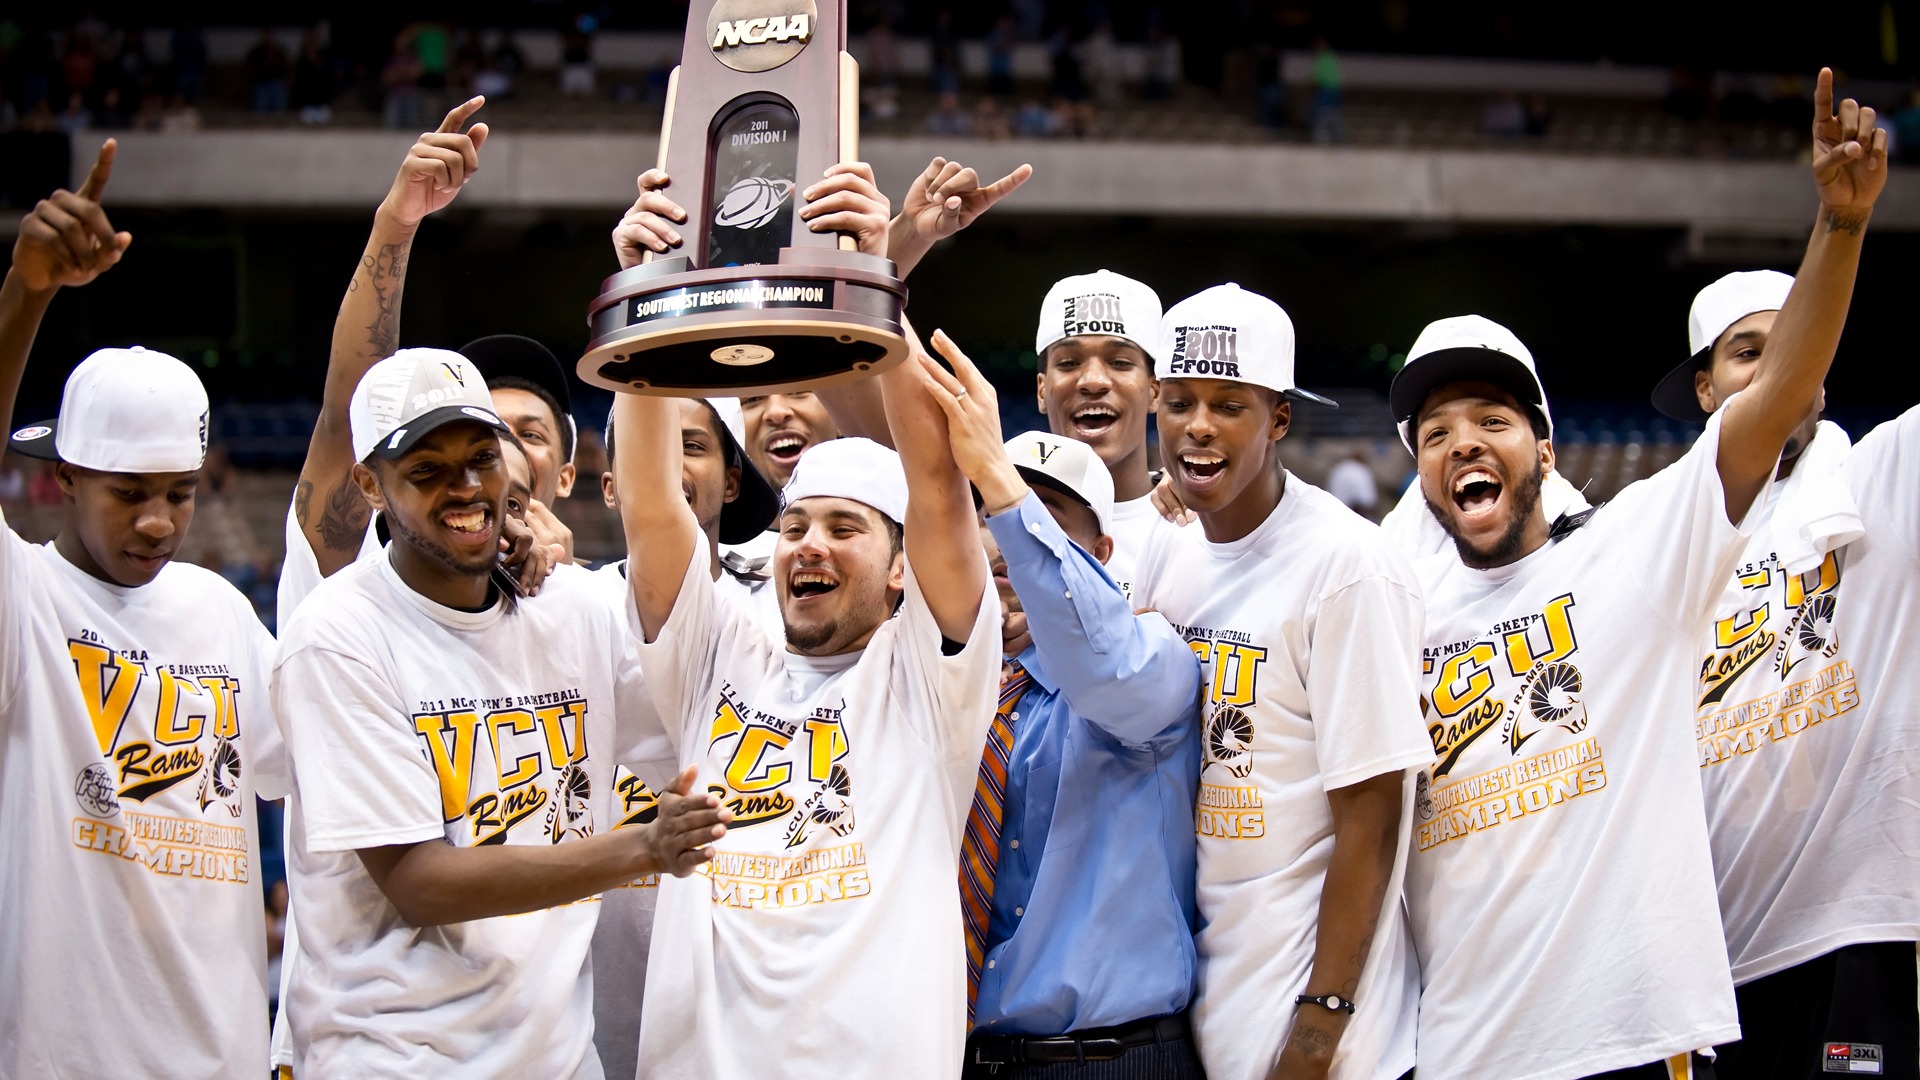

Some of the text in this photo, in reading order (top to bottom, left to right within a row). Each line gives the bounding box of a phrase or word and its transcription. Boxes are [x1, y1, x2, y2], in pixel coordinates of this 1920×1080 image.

[712, 14, 811, 51] NCAA
[731, 130, 787, 147] DIVISION I
[751, 120, 769, 131] 2011
[761, 286, 824, 303] CHAMPION
[1076, 297, 1124, 322] 2011
[1063, 297, 1076, 337] FINAL
[1076, 320, 1126, 335] FOUR
[1170, 325, 1188, 374] FINAL
[1185, 330, 1239, 363] 2011
[1182, 359, 1241, 378] FOUR
[412, 386, 465, 411] 2011
[1714, 548, 1841, 650] CU
[1773, 595, 1814, 673] VCU RAMS
[179, 664, 230, 675] BASKETBAL
[1423, 592, 1579, 719] CU
[67, 638, 241, 758] VCU
[1501, 660, 1545, 745] VCU RAMS
[1780, 661, 1855, 708] REGIONAL
[754, 711, 798, 736] MEN'S
[1699, 684, 1861, 767] AMPIONS
[114, 743, 204, 786] Rams
[412, 698, 589, 824] VCU
[1431, 767, 1511, 813] SOUTHWEST
[1516, 740, 1602, 784] REGIONAL
[466, 785, 548, 838] Rms
[543, 801, 557, 836] VCU
[1416, 763, 1608, 851] CHAMPIONS
[125, 813, 248, 852] UTHWEST REGIONAL
[712, 843, 867, 881] THWEST REGIONAL
[711, 868, 872, 910] MPIONS
[1853, 1048, 1878, 1060] 3XL
